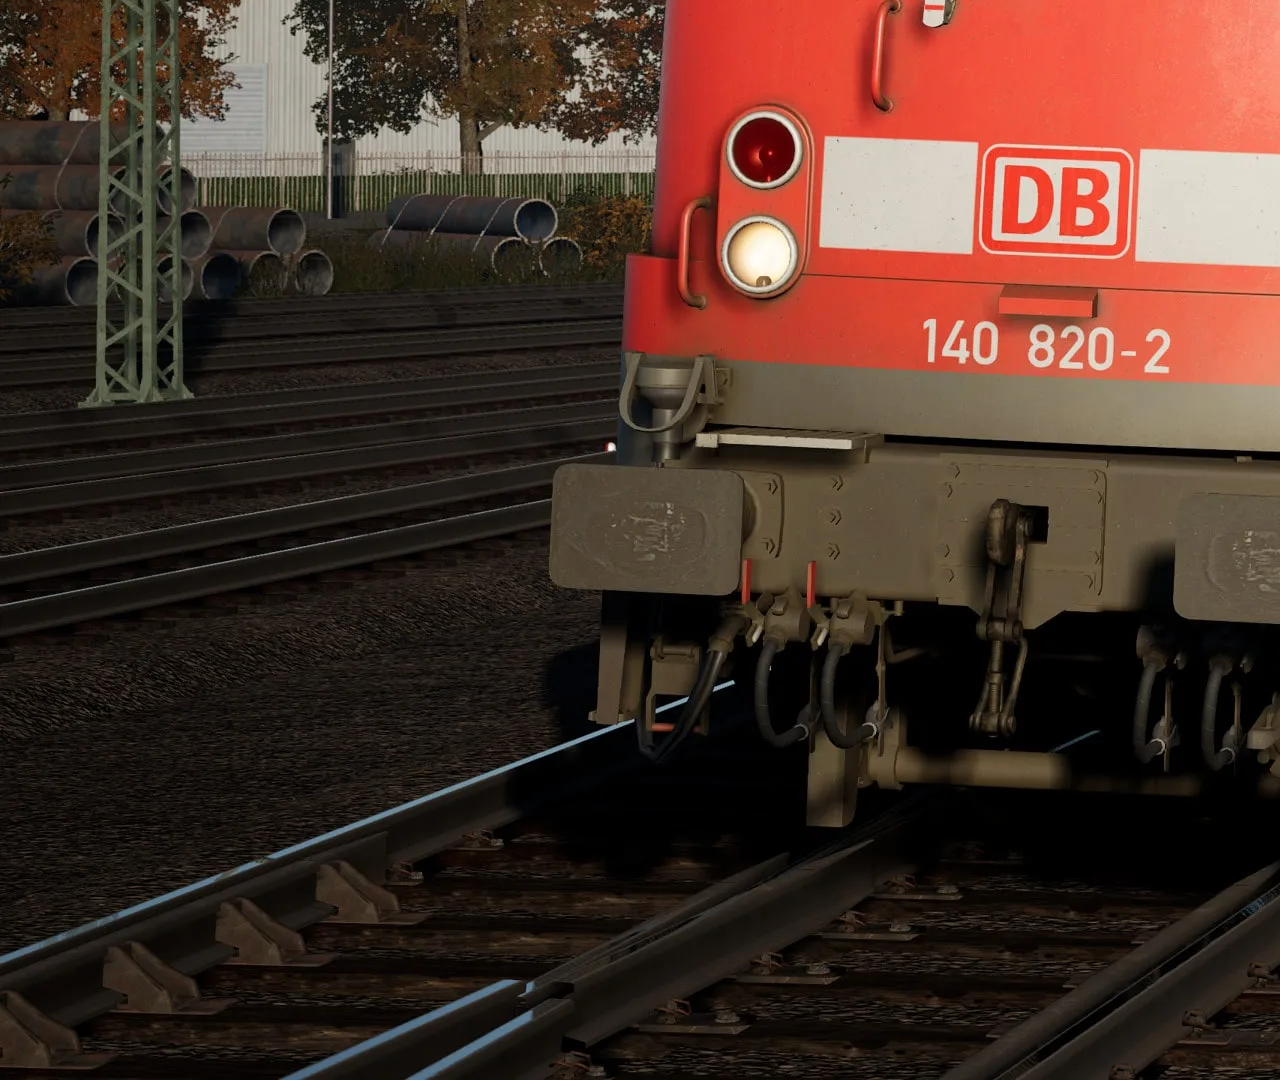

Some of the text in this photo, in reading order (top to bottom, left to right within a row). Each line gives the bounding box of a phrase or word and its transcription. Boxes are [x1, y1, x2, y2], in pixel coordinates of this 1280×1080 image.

[1001, 164, 1110, 237] DB
[922, 318, 1171, 374] 140 820-2
